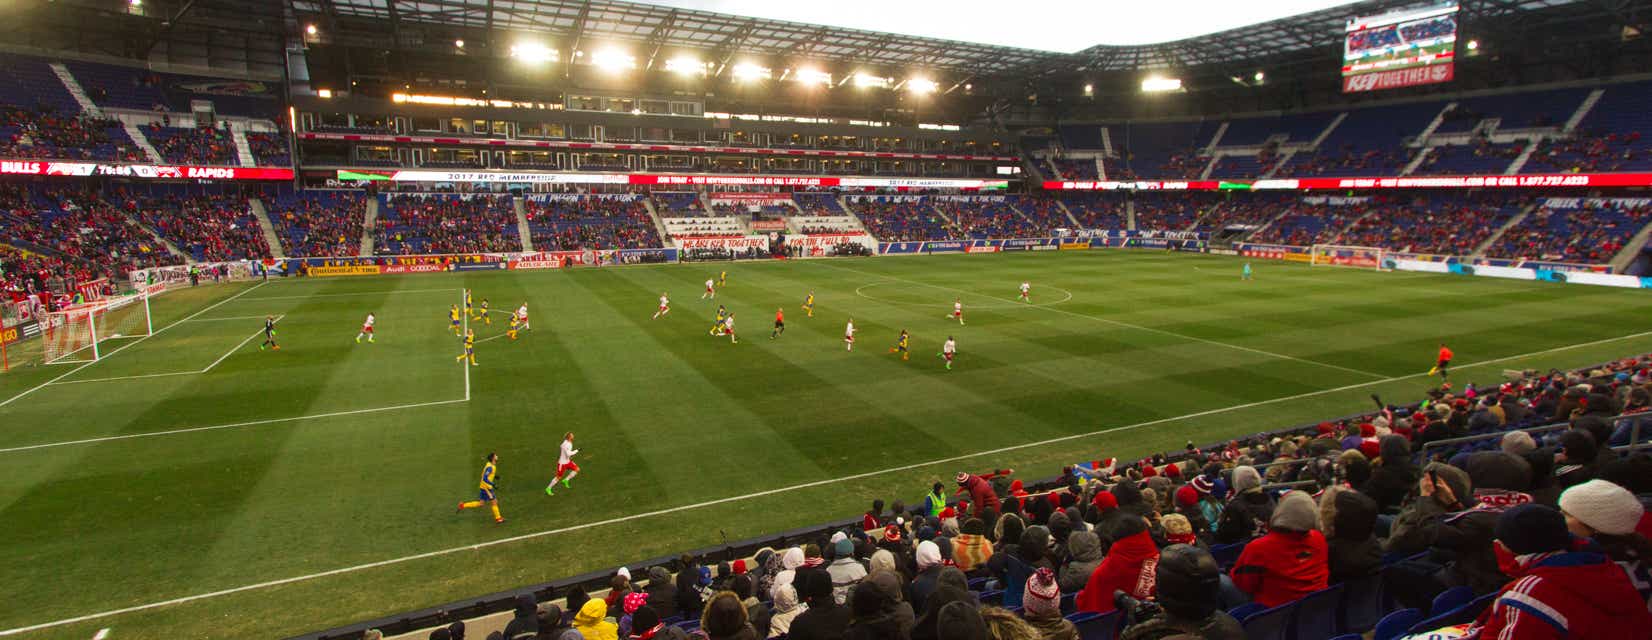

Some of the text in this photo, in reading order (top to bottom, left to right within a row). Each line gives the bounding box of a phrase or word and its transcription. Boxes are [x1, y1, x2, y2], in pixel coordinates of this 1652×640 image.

[1, 162, 40, 174] BULLS
[187, 167, 234, 178] RAPIDS
[448, 173, 474, 181] 2017
[774, 178, 785, 186] CALL
[1485, 177, 1497, 186] OR
[1499, 176, 1517, 186] CALL
[728, 238, 766, 249] TOGETHER
[386, 265, 405, 273] Audi
